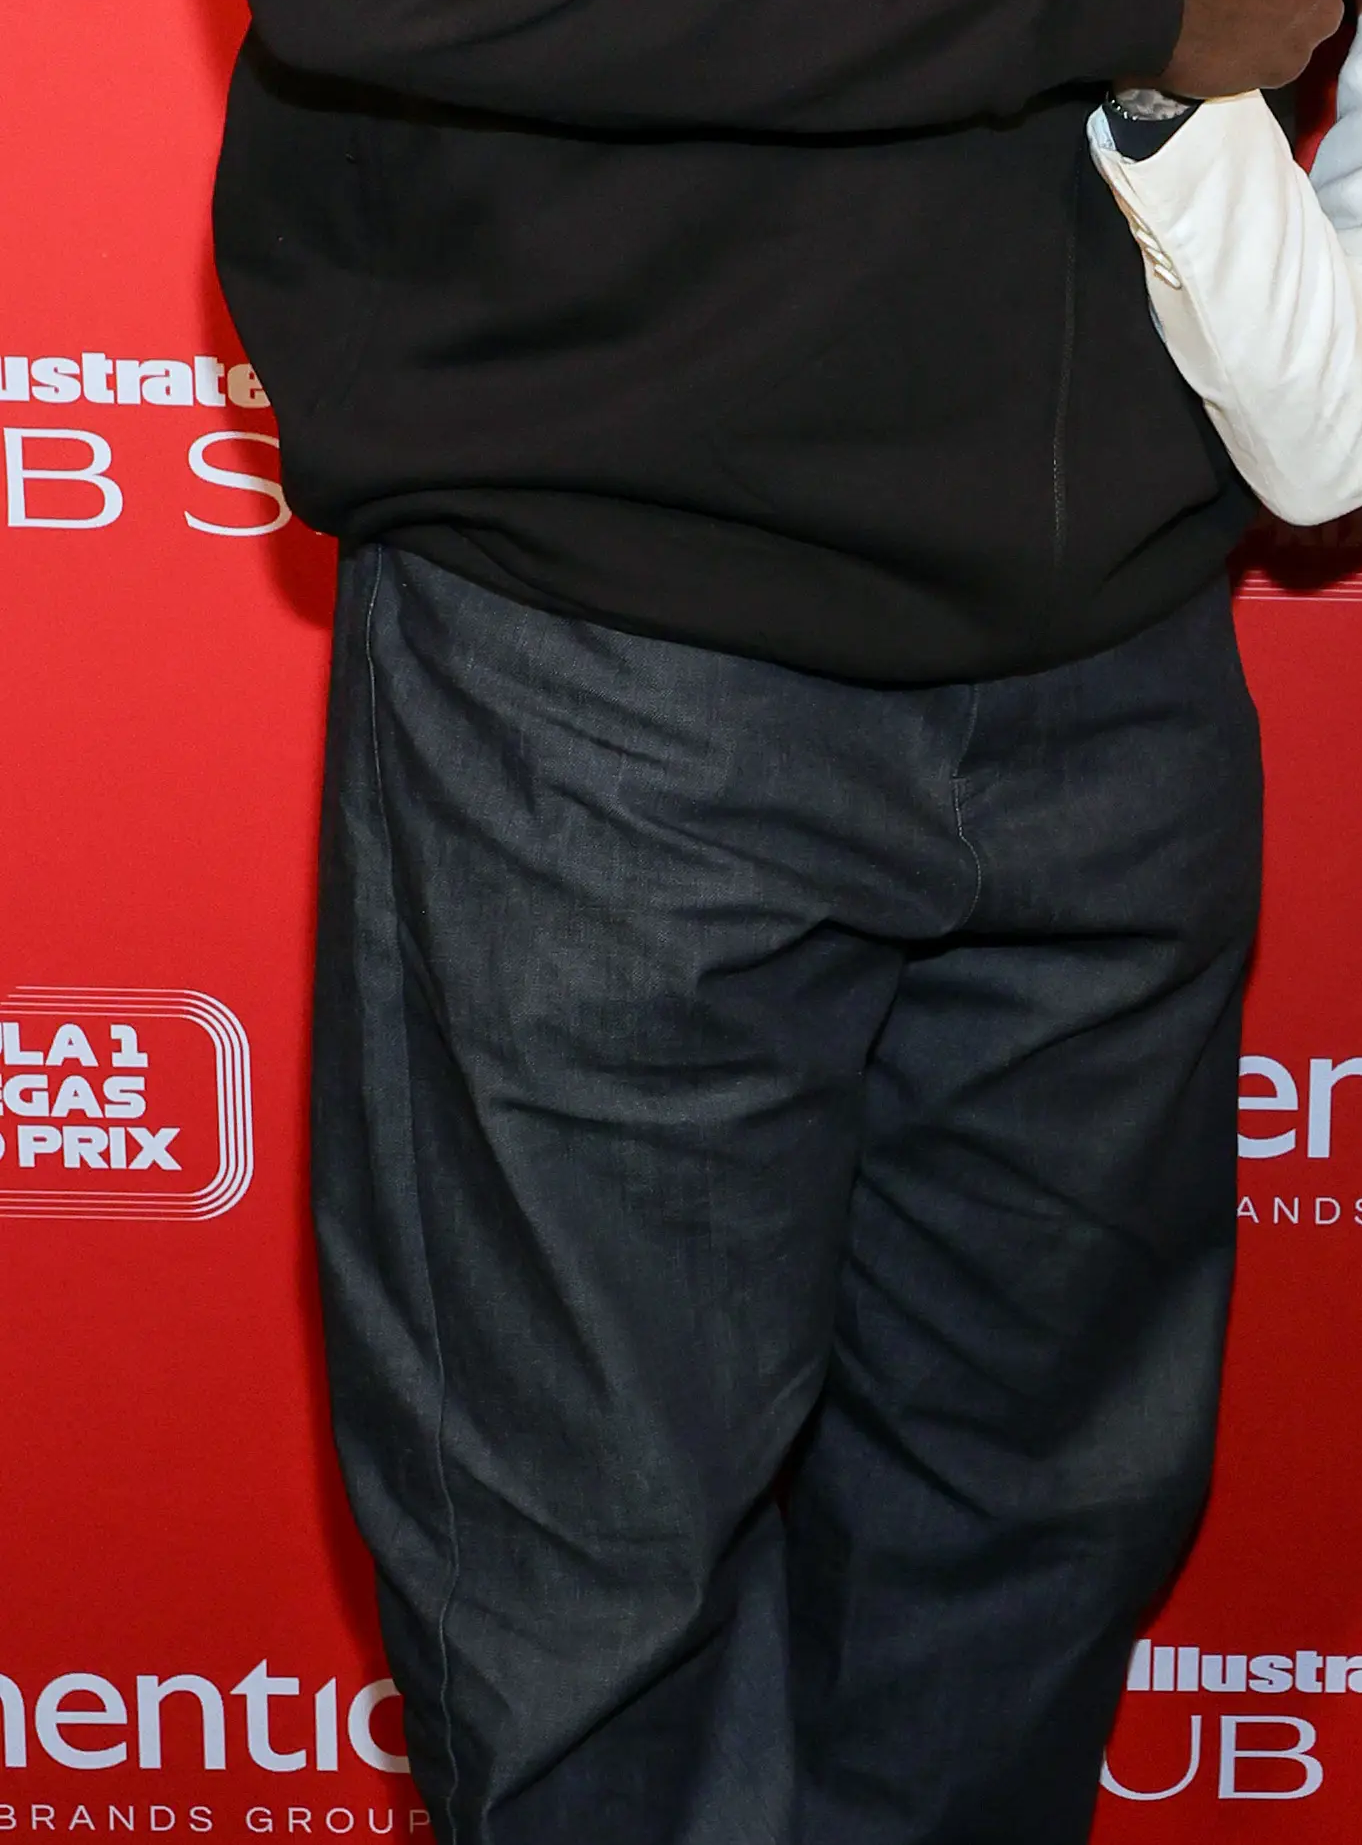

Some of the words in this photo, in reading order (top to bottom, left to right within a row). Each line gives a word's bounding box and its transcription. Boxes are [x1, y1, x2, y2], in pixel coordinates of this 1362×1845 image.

[0, 1022, 98, 1067] LA
[110, 1024, 148, 1068] 1
[0, 1074, 147, 1119] GAS
[18, 1125, 182, 1170] PRIX
[0, 1657, 412, 1773] entic
